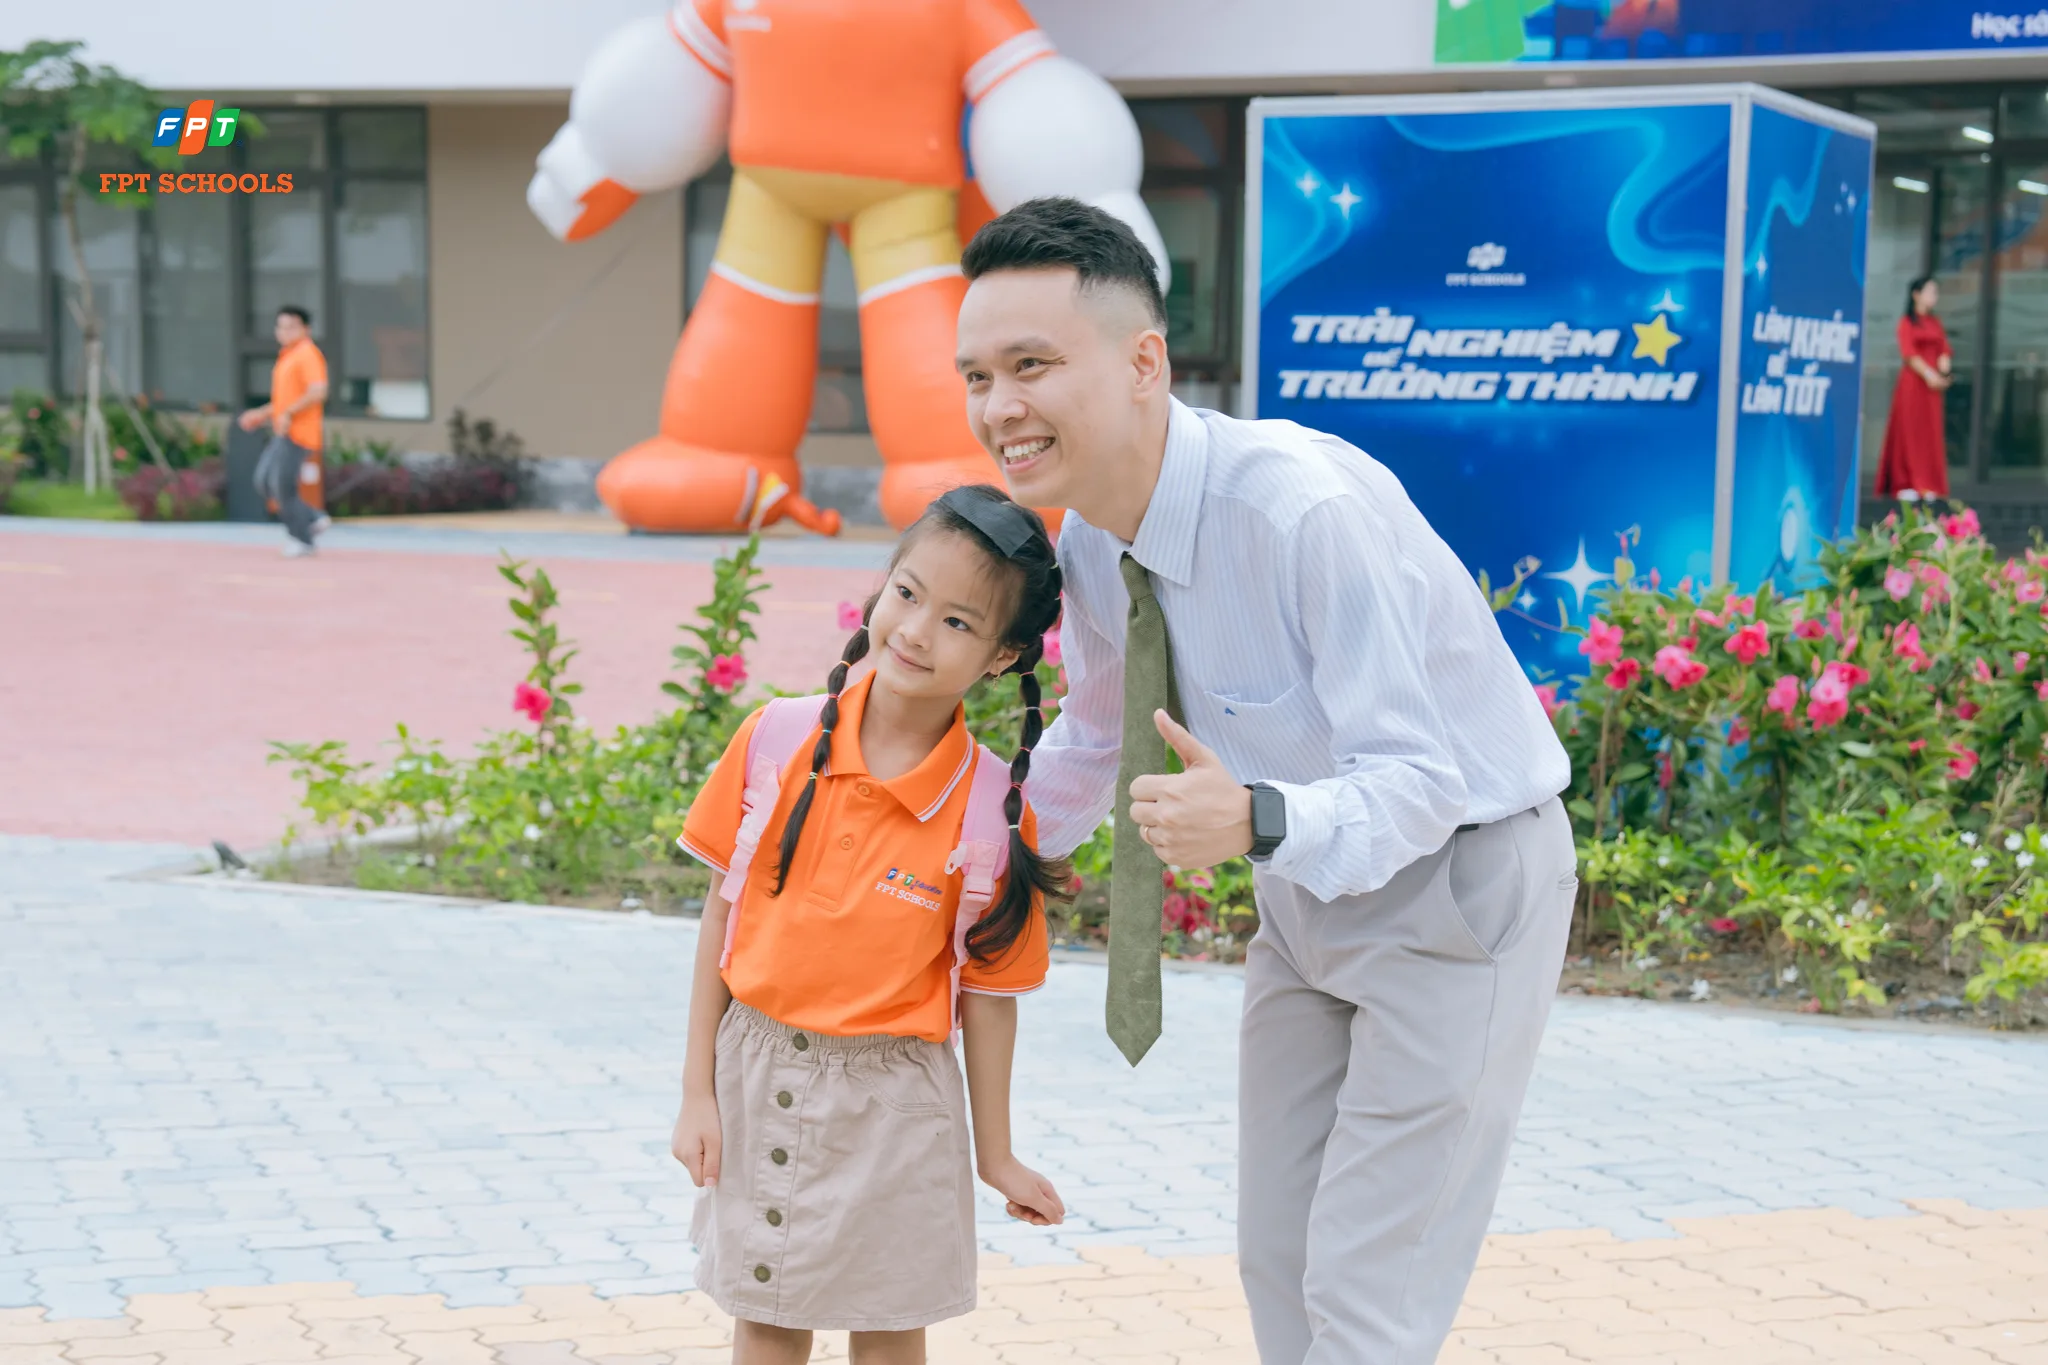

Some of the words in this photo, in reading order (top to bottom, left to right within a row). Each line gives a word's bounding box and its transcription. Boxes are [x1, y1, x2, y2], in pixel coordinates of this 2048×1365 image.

[1971, 11, 2021, 42] Học
[1291, 307, 1415, 343] TRẢI
[1406, 321, 1621, 364] NGHIỆM
[1790, 309, 1860, 364] KHÁC
[1278, 362, 1502, 400] TRƯỞNG
[1505, 364, 1698, 400] THÀNH
[1783, 361, 1832, 416] TỐT
[886, 868, 914, 886] FPT
[875, 882, 897, 895] FPT
[897, 889, 941, 912] SCHOOLS
